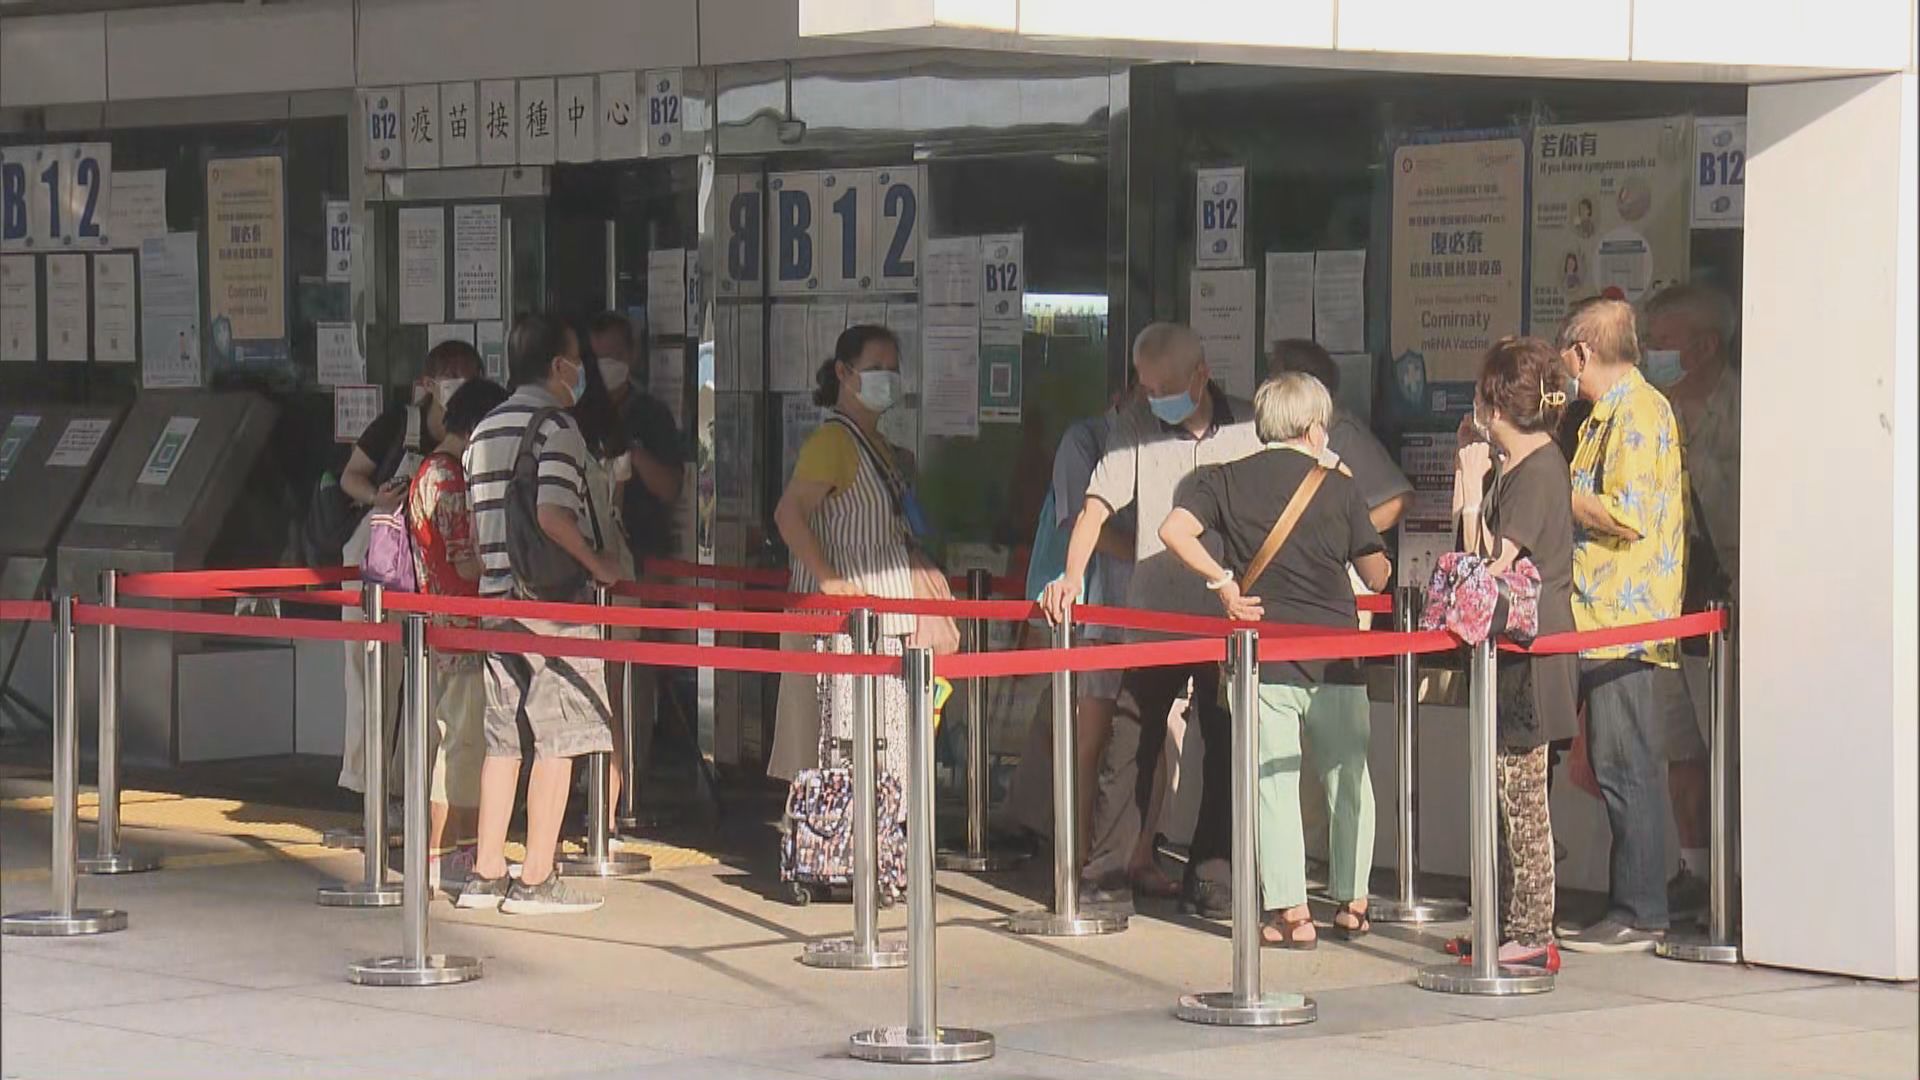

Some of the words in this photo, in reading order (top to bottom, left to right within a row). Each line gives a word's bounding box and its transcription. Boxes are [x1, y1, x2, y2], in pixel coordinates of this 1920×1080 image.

[410, 96, 631, 144] 疫苗接種中心
[650, 95, 679, 125] B12
[372, 112, 396, 140] B12
[1540, 131, 1598, 159] 若你有
[1700, 151, 1744, 185] B12
[2, 158, 101, 240] B12
[1203, 198, 1237, 229] B12
[778, 184, 917, 281] B12
[986, 262, 1017, 293] B12
[1421, 310, 1490, 331] Comirnaty
